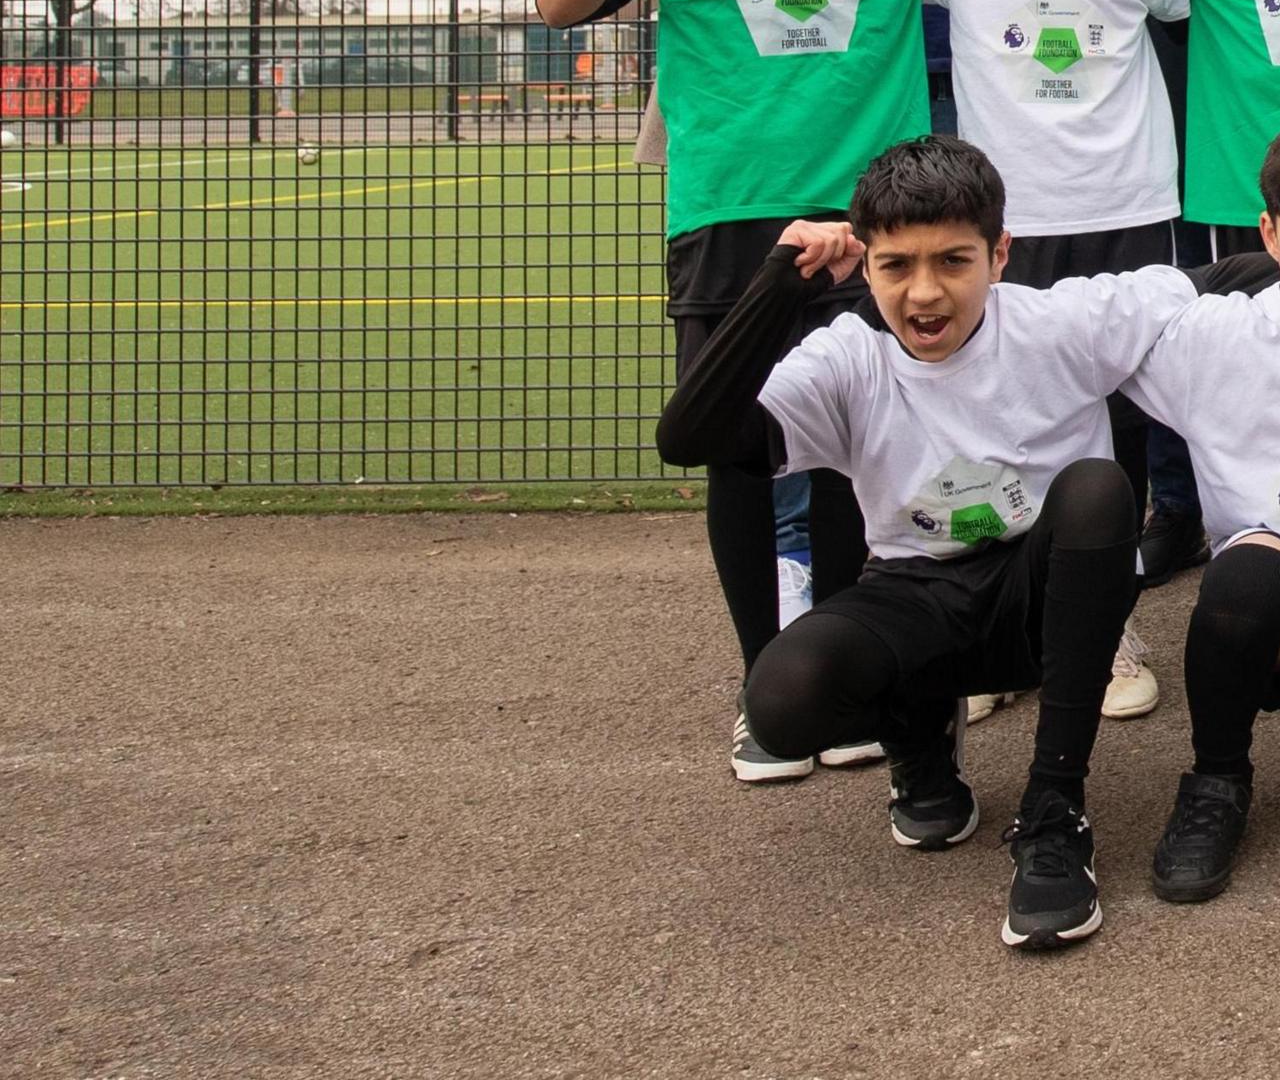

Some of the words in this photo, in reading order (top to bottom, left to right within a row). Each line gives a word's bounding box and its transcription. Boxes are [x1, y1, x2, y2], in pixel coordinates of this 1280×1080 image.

[787, 28, 820, 38] TOGETHER
[781, 39, 795, 49] FOR
[796, 38, 827, 47] FOOTBALL
[1042, 40, 1072, 48] FOOTBALL
[1039, 49, 1077, 58] FOUNDATION
[1042, 80, 1072, 88] TOGETHER
[1035, 89, 1048, 98] FOR
[1049, 89, 1078, 98] FOOTBALL
